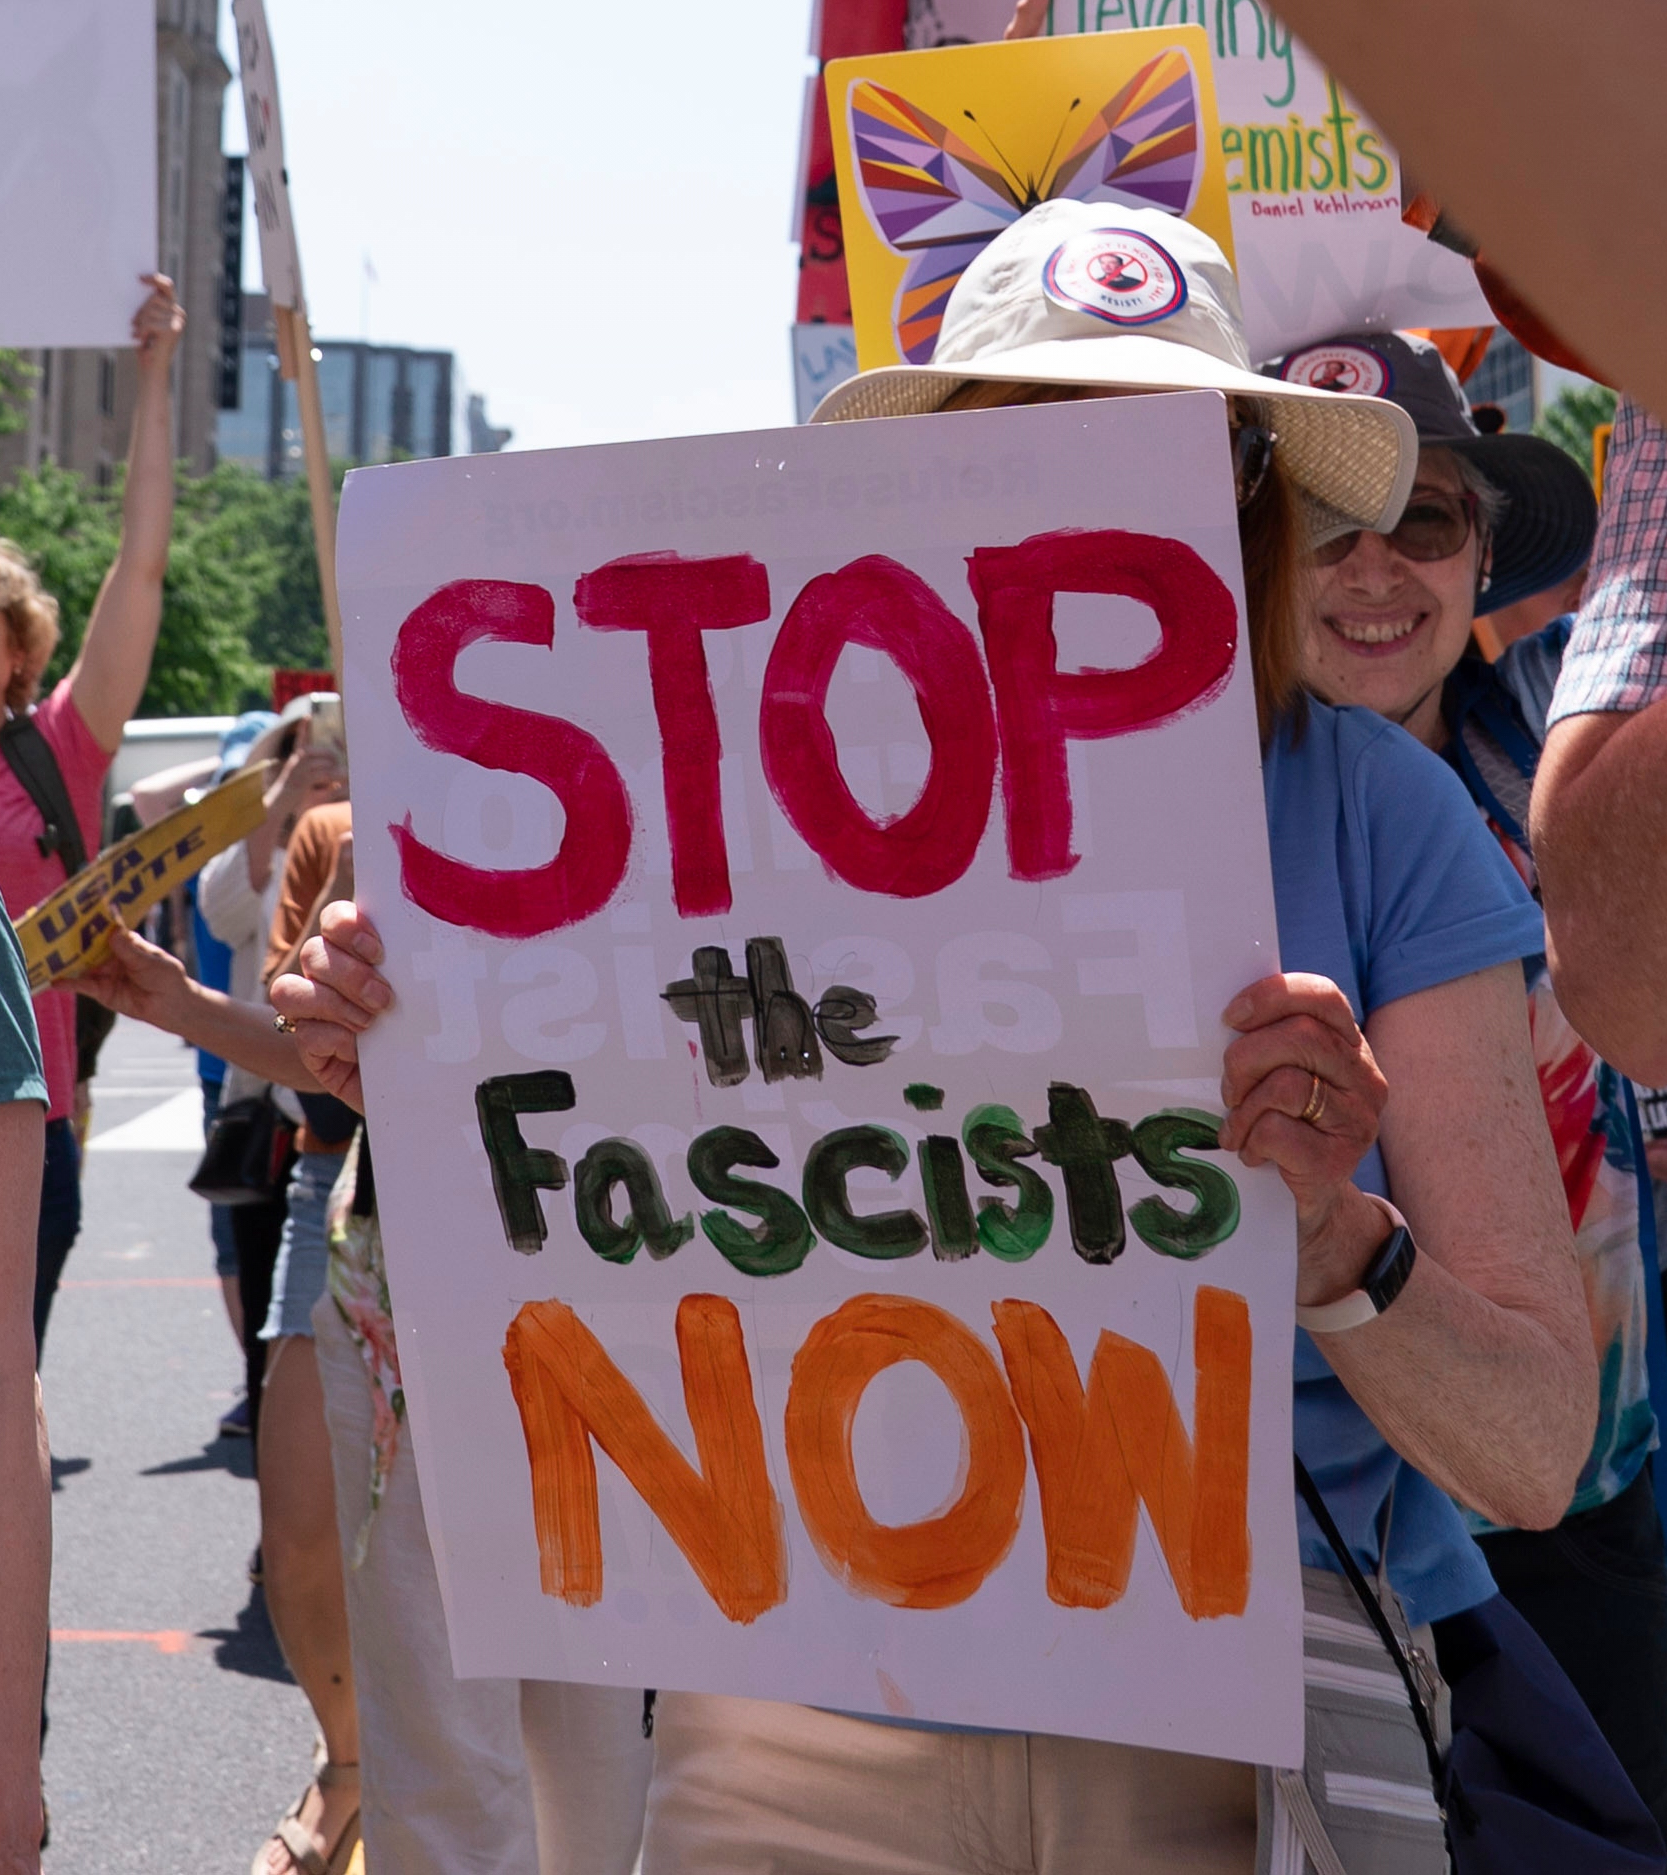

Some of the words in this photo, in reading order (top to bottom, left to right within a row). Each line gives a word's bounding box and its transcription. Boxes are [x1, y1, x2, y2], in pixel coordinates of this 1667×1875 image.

[1221, 75, 1390, 193] emists
[1251, 196, 1305, 218] Daniel
[387, 527, 1239, 940] STOP
[37, 847, 145, 944] USA
[658, 934, 903, 1088] the
[473, 1069, 1242, 1278] Fascists
[501, 1283, 1253, 1625] NOW
